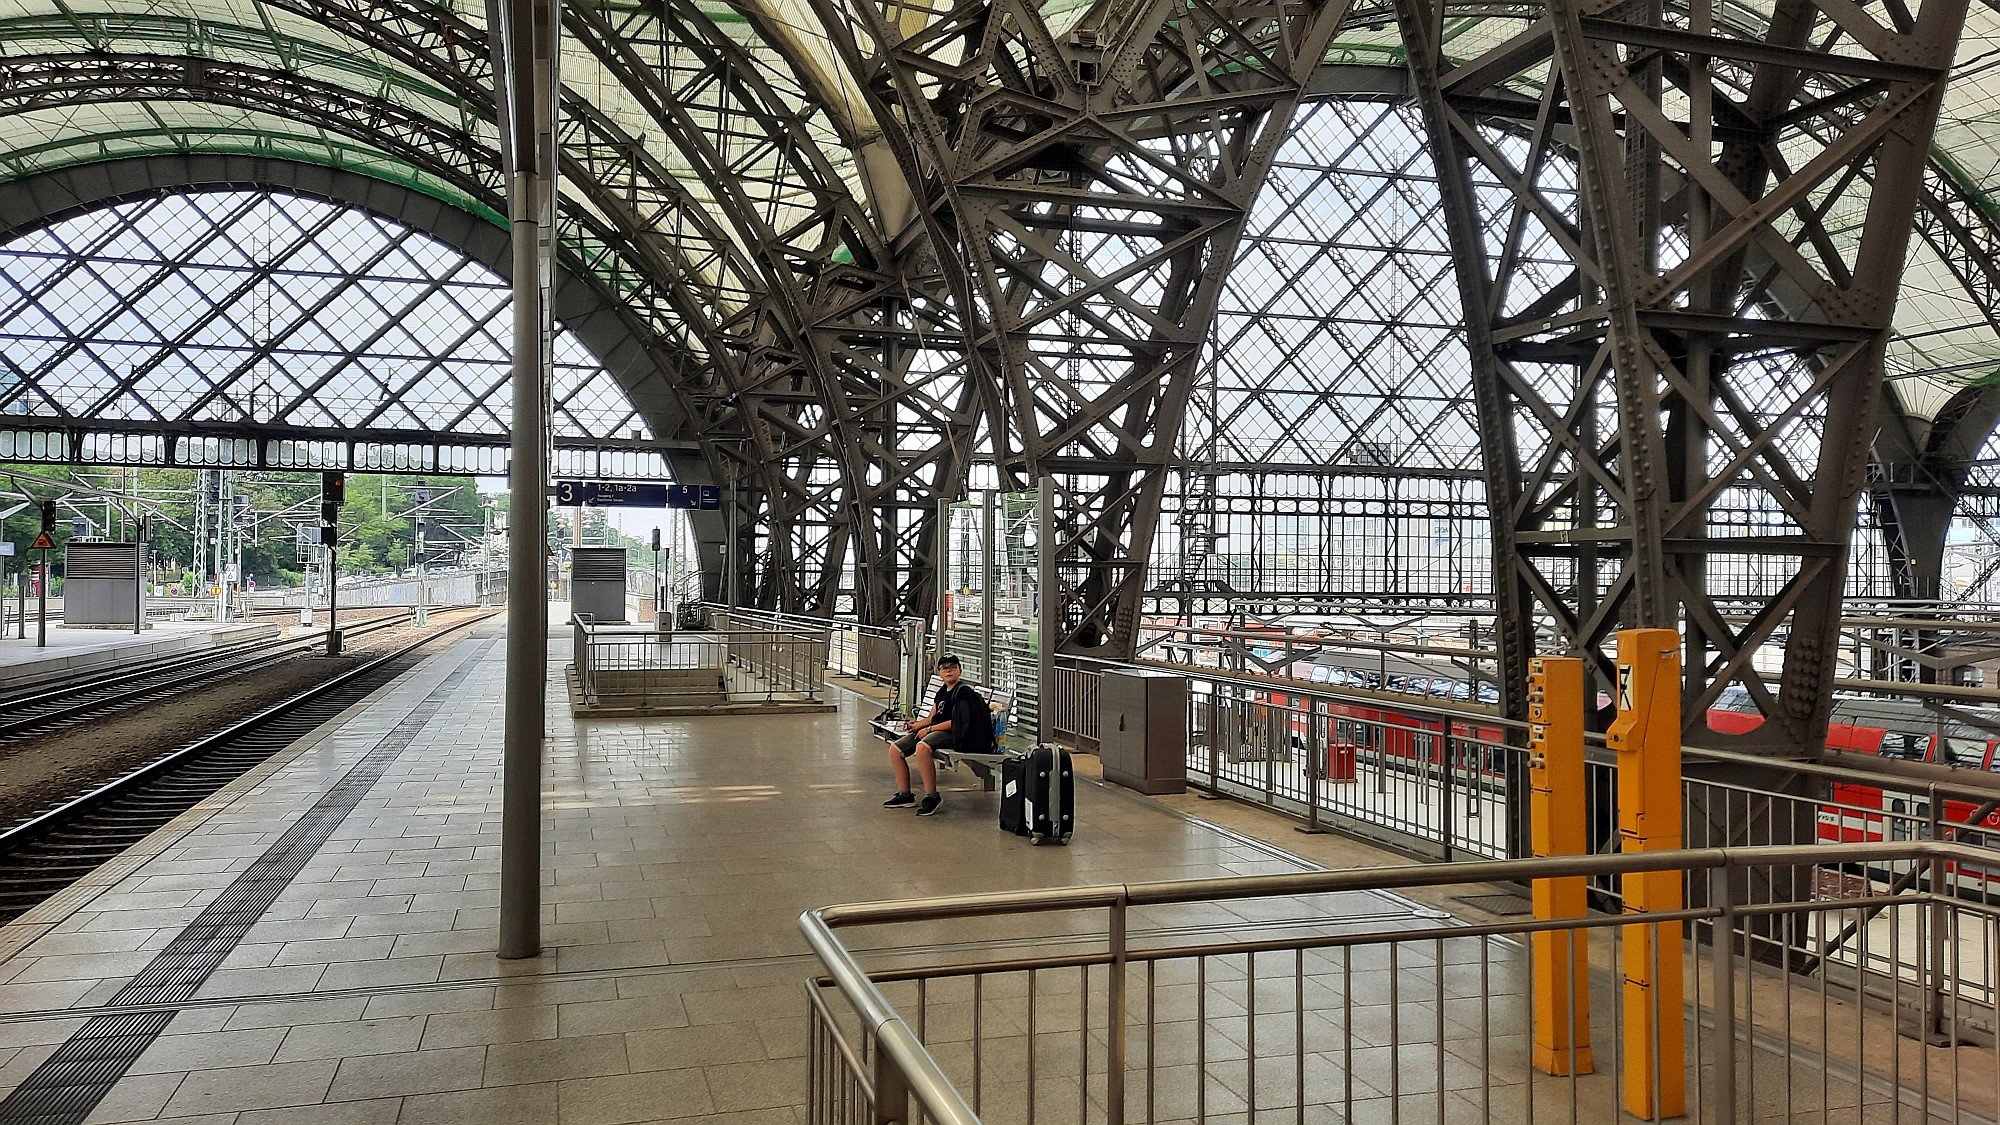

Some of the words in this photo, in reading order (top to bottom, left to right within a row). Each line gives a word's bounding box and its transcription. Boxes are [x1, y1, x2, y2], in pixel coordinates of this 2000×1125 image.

[597, 483, 612, 492] 1-2,
[614, 484, 637, 492] 1a-2a
[682, 486, 688, 494] 5
[560, 483, 573, 502] 3
